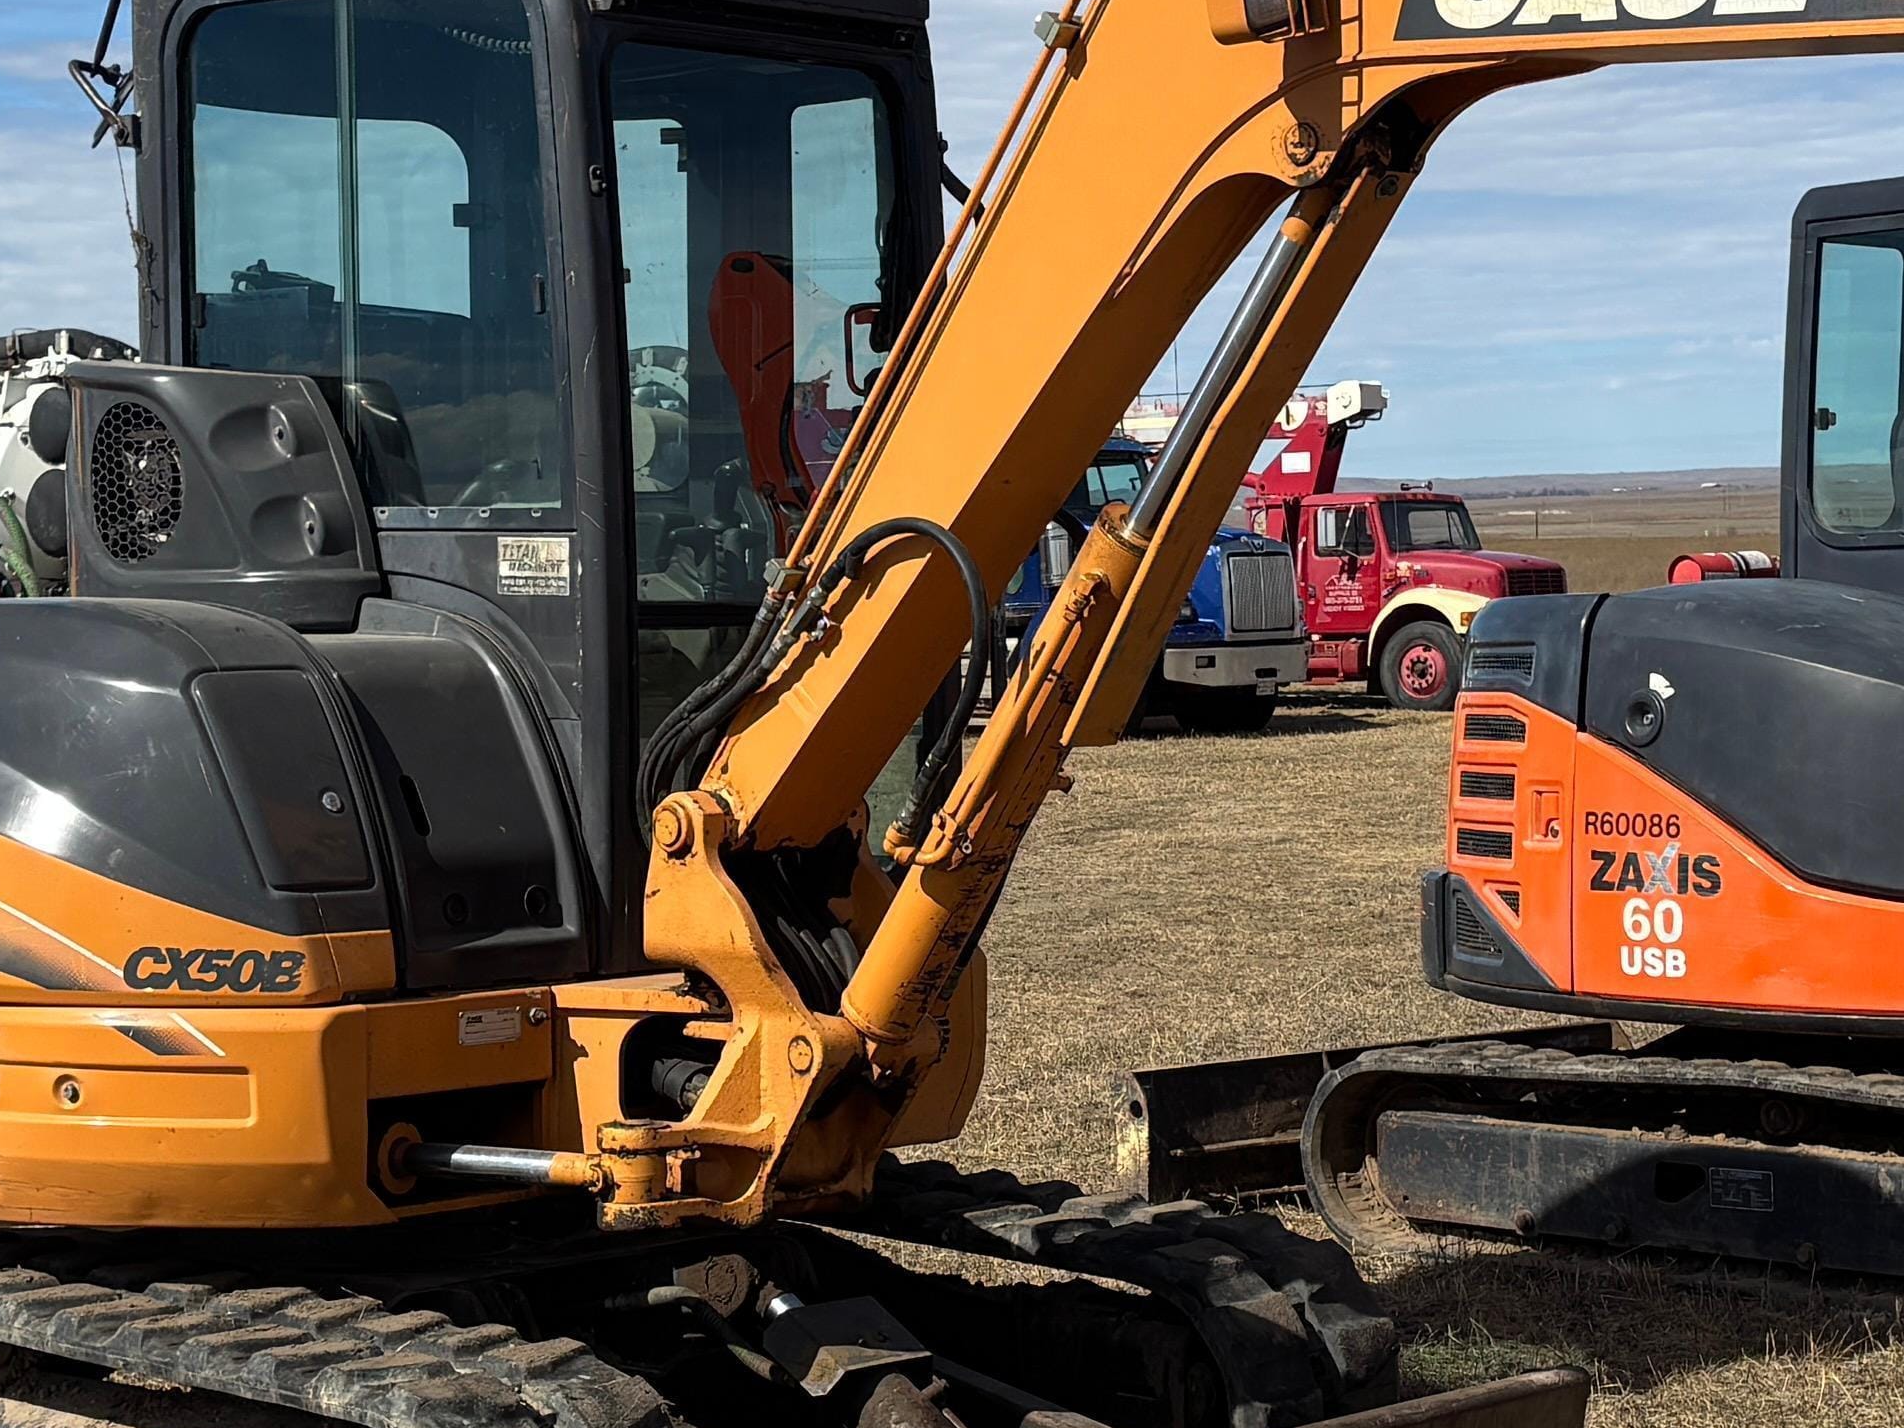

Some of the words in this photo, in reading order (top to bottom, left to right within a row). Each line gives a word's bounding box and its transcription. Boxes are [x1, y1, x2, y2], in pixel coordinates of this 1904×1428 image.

[1584, 811, 1681, 840] R60086
[1589, 841, 1722, 897] ZAXIS
[1622, 897, 1684, 944] 60
[122, 946, 307, 993] CX50B
[1619, 945, 1687, 978] USB
